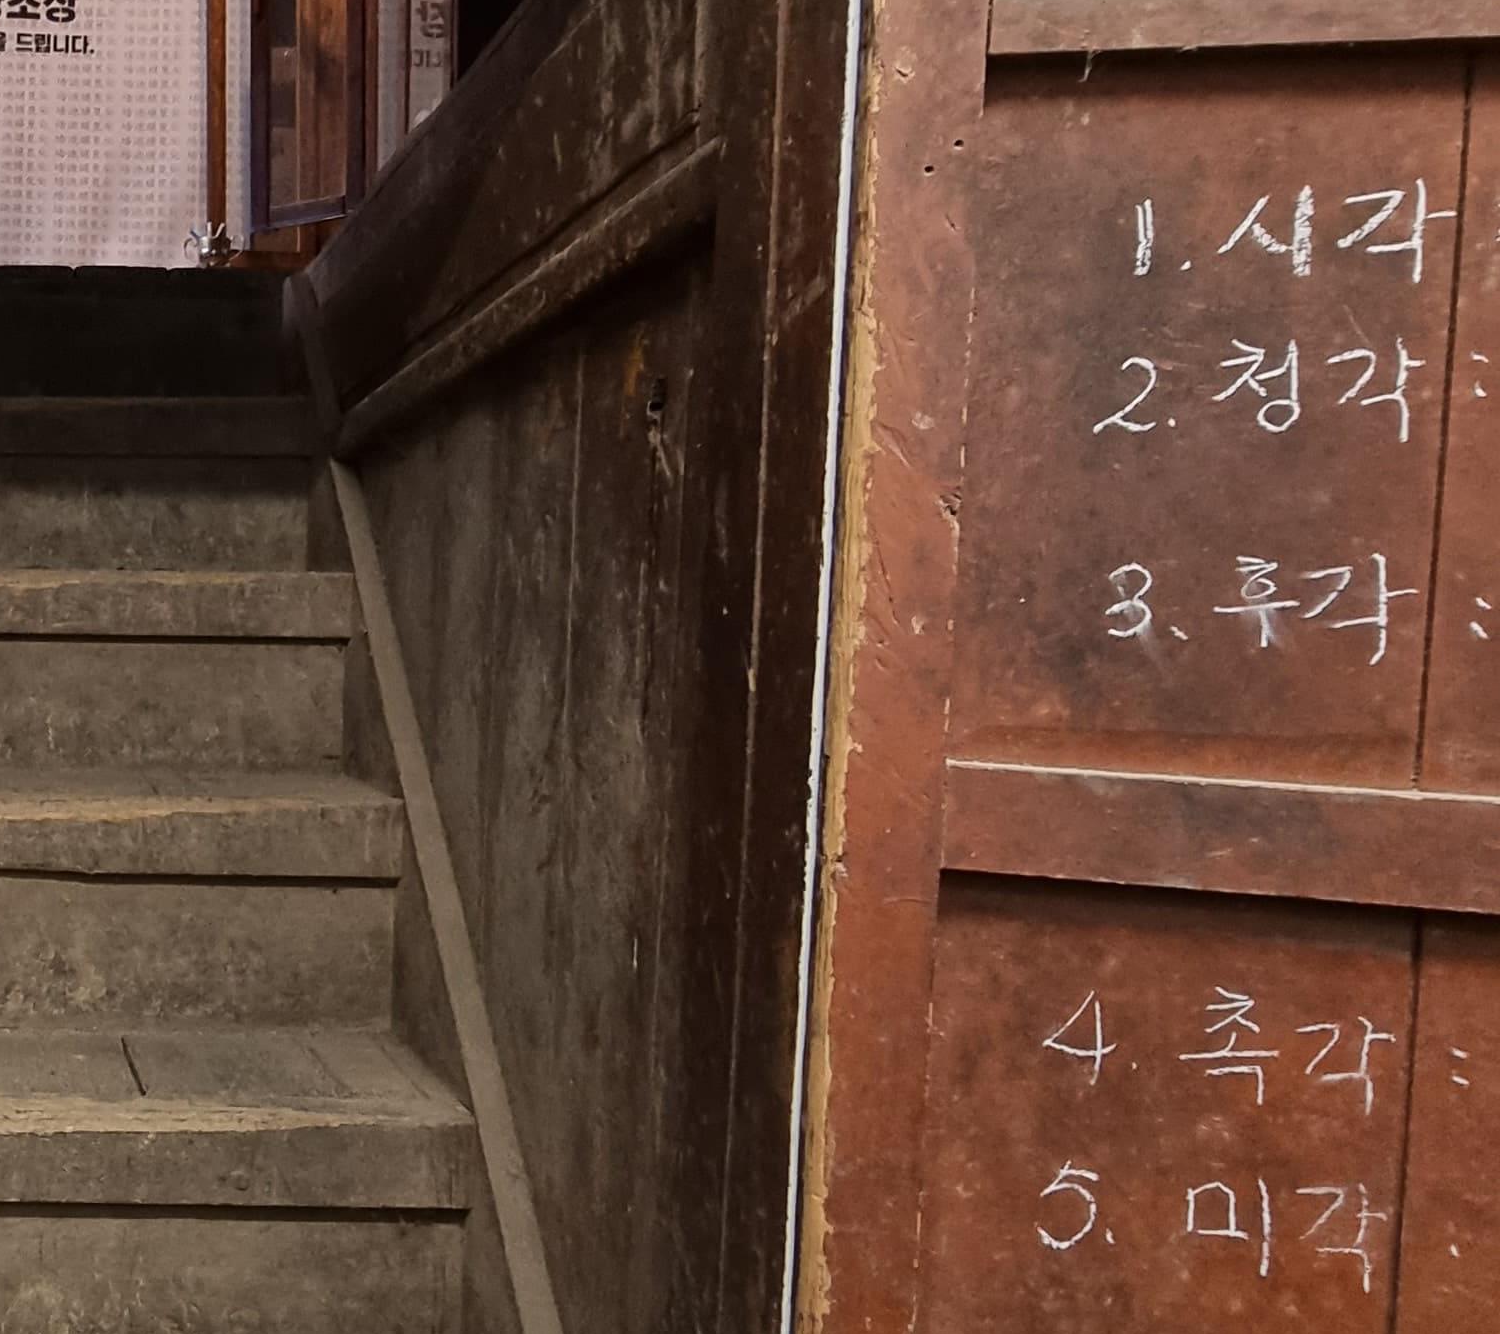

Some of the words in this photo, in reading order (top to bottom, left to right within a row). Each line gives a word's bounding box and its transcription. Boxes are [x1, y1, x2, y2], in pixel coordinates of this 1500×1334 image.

[15, 33, 95, 55] 드립니다.
[1217, 178, 1457, 284] 시각
[1093, 356, 1177, 433] 2.
[1212, 338, 1427, 443] 청각
[1105, 563, 1189, 642] 3.
[1212, 553, 1419, 665] 후각
[1042, 990, 1138, 1086] 4.
[1178, 986, 1396, 1115] 촉각
[1036, 1160, 1116, 1250] 5.
[1184, 1176, 1389, 1294] 미각
